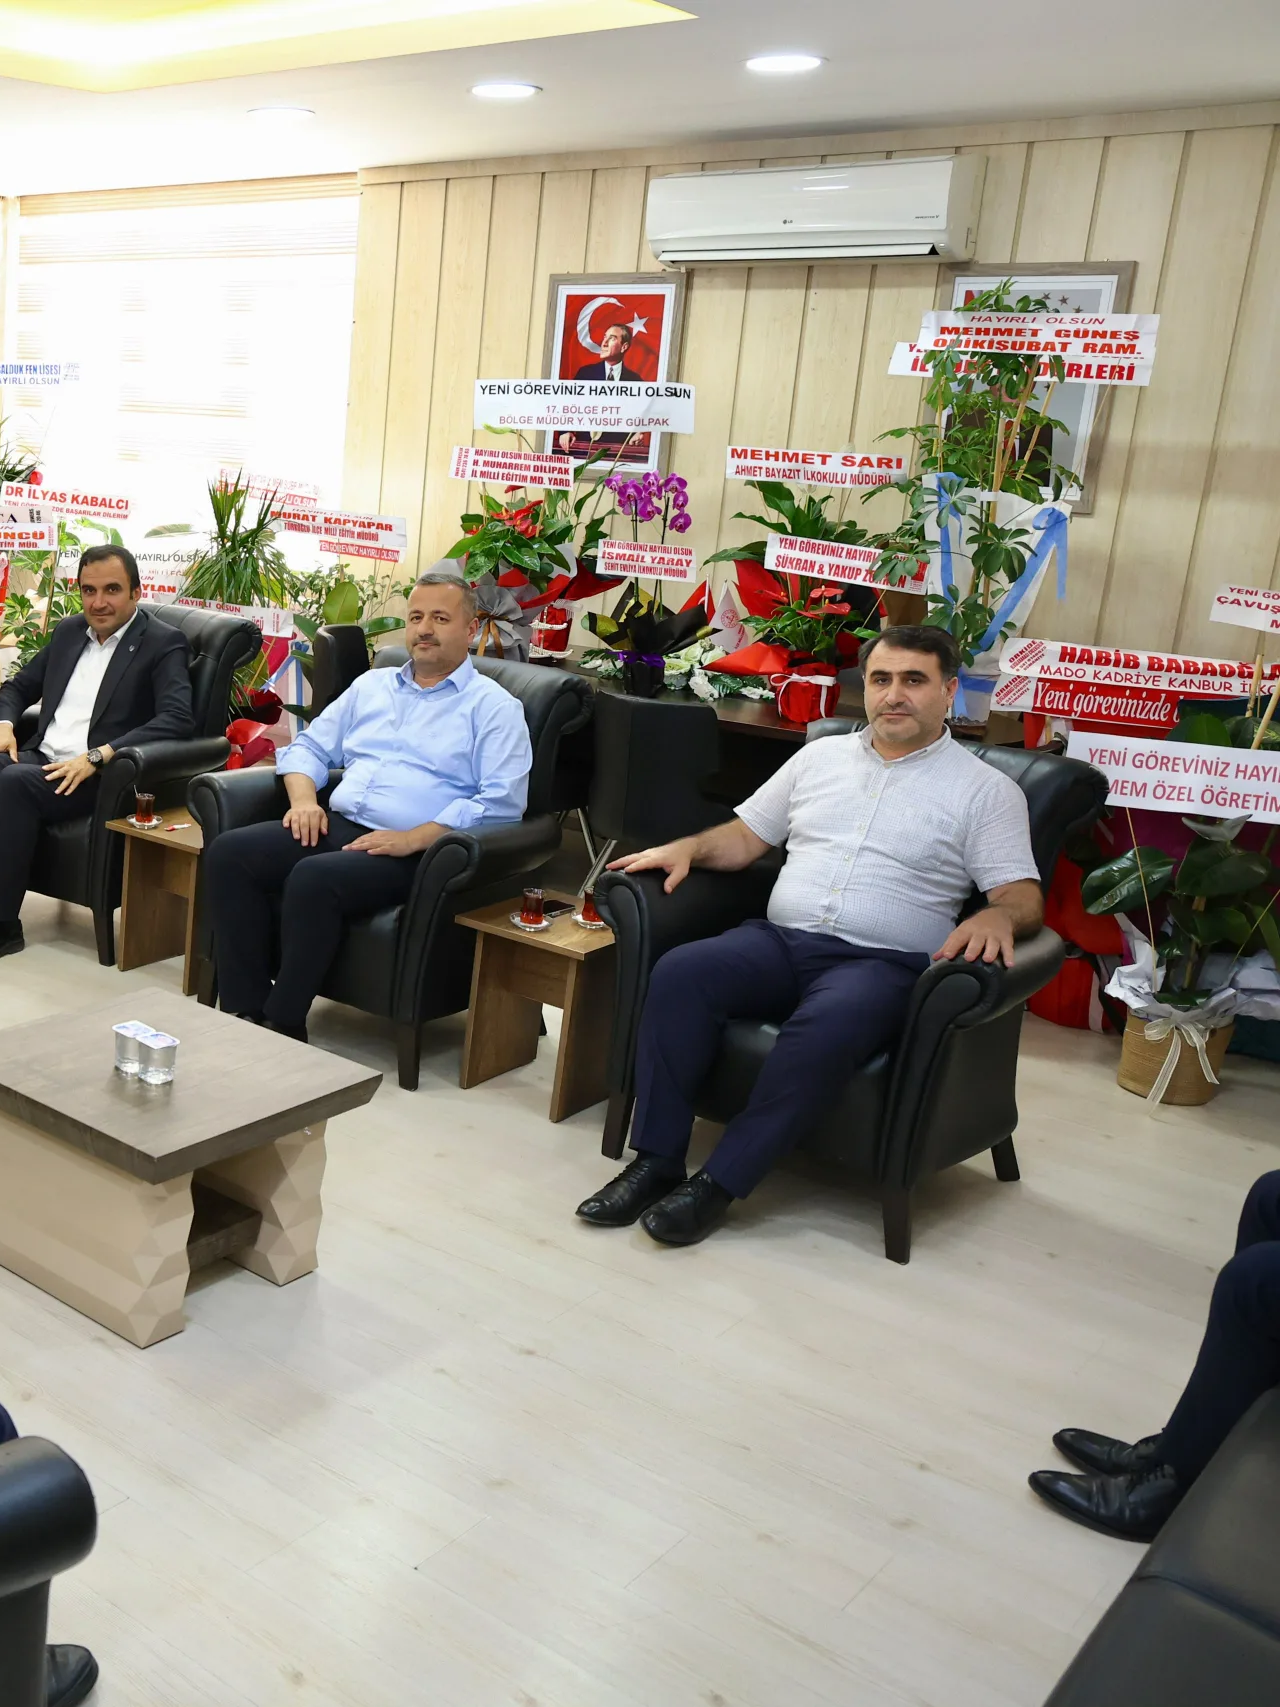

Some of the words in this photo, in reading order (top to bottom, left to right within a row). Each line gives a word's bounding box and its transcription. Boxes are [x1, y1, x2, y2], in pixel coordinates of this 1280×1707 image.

[970, 315, 1037, 324] HAYIRLI
[1045, 316, 1106, 325] OLSUN
[940, 326, 1043, 338] MEHMET
[1054, 328, 1140, 342] GÜNEŞ
[1082, 342, 1142, 355] RAM.
[480, 382, 510, 395] YENİ
[513, 382, 585, 397] GÖREVİNİZ
[589, 385, 641, 397] HAYIRLI
[645, 386, 691, 400] OLSUN
[546, 406, 559, 414] 17.
[562, 403, 598, 415] BÖLGE
[601, 406, 621, 415] PTT
[499, 413, 533, 425] BÖLGE
[536, 414, 575, 426] MÜDÜR
[588, 417, 622, 426] YUSUF
[625, 416, 669, 427] GÜLPAK
[474, 448, 500, 458] HAYIRLI
[500, 450, 522, 460] OLSUN
[730, 447, 832, 466] MEHMET
[841, 455, 903, 470] SARI
[482, 460, 531, 472] MUHARREM
[532, 464, 570, 476] DİLİPAK
[735, 464, 763, 477] AHMET
[765, 467, 801, 480] BAYAZIT
[803, 466, 847, 485] İLKOKULU
[849, 472, 891, 486] MÜDÜRÜ
[479, 470, 500, 480] MİLLİ
[501, 471, 528, 483] EĞİTİM
[530, 476, 546, 485] MD.
[5, 486, 24, 498] DR
[28, 486, 68, 503] İLYAS
[70, 494, 129, 510] KABALCI
[270, 510, 318, 522] MURAT
[324, 516, 393, 532] KAPYAPAR
[649, 544, 672, 555] HAYIRLI
[673, 547, 693, 556] OLSUN
[779, 536, 798, 551] YENİ
[799, 538, 845, 559] GÖREVİNİZ
[602, 550, 646, 564] İSMAİL
[774, 555, 817, 574] ŞÜKRAN
[818, 564, 825, 576] &
[827, 564, 862, 581] YAKUP
[216, 603, 241, 613] OLSUN
[1058, 645, 1141, 670] HABİB
[1039, 664, 1087, 679] MADO
[1092, 669, 1162, 688] KADRİYE
[1168, 676, 1233, 693] KANBUR
[1034, 680, 1071, 710] Yeni
[1073, 686, 1172, 723] görevinizde
[1088, 746, 1128, 767] YENİ
[1132, 750, 1231, 778] GÖREVİNİZ
[1152, 780, 1195, 803] ÖZEL
